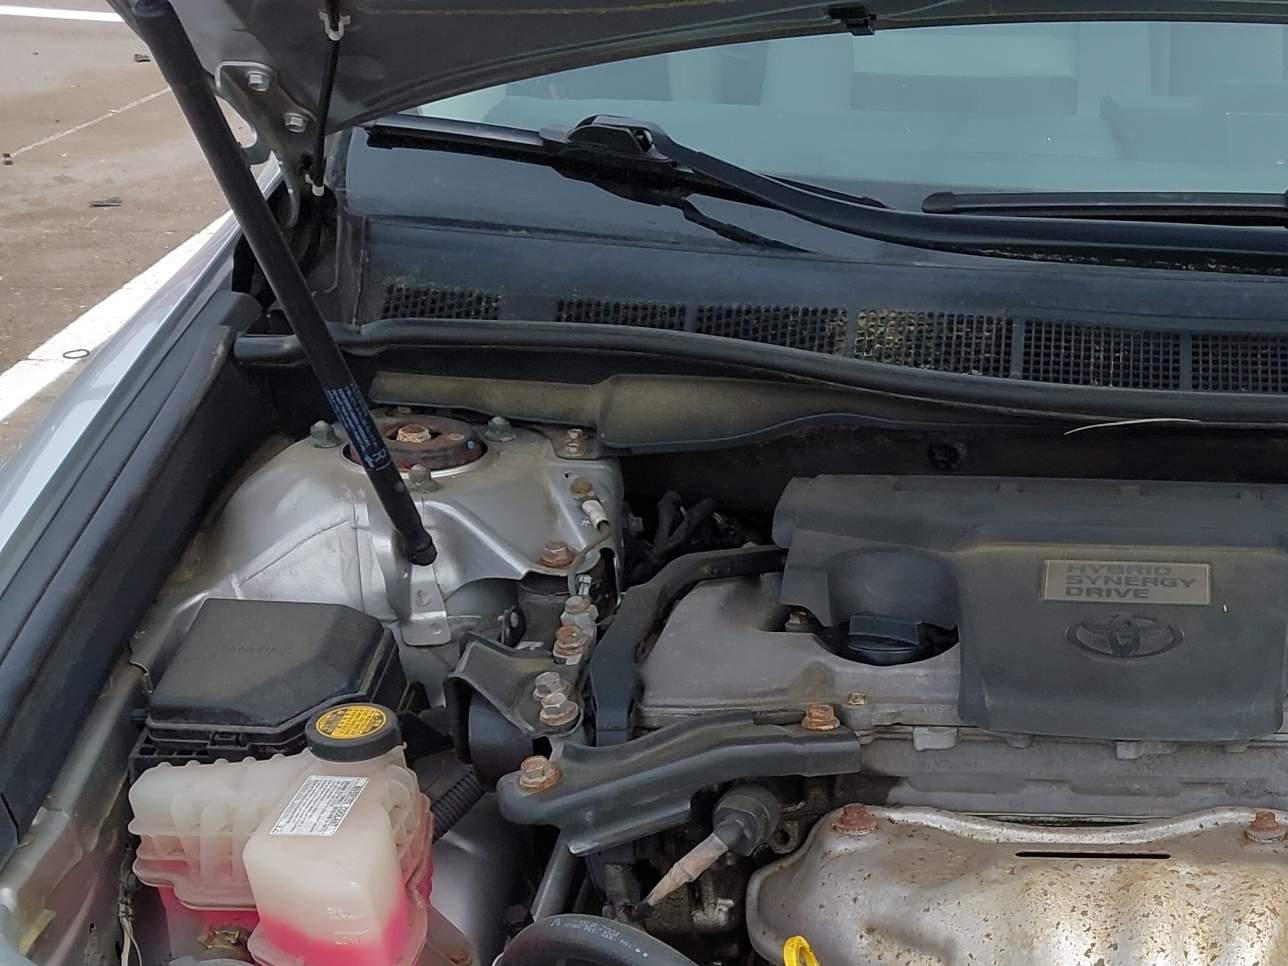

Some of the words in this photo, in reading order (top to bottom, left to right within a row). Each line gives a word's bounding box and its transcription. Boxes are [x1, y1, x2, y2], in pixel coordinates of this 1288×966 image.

[1067, 564, 1172, 576] HYBRID
[1066, 575, 1198, 588] SYNERGY
[1065, 586, 1150, 599] DRIVE
